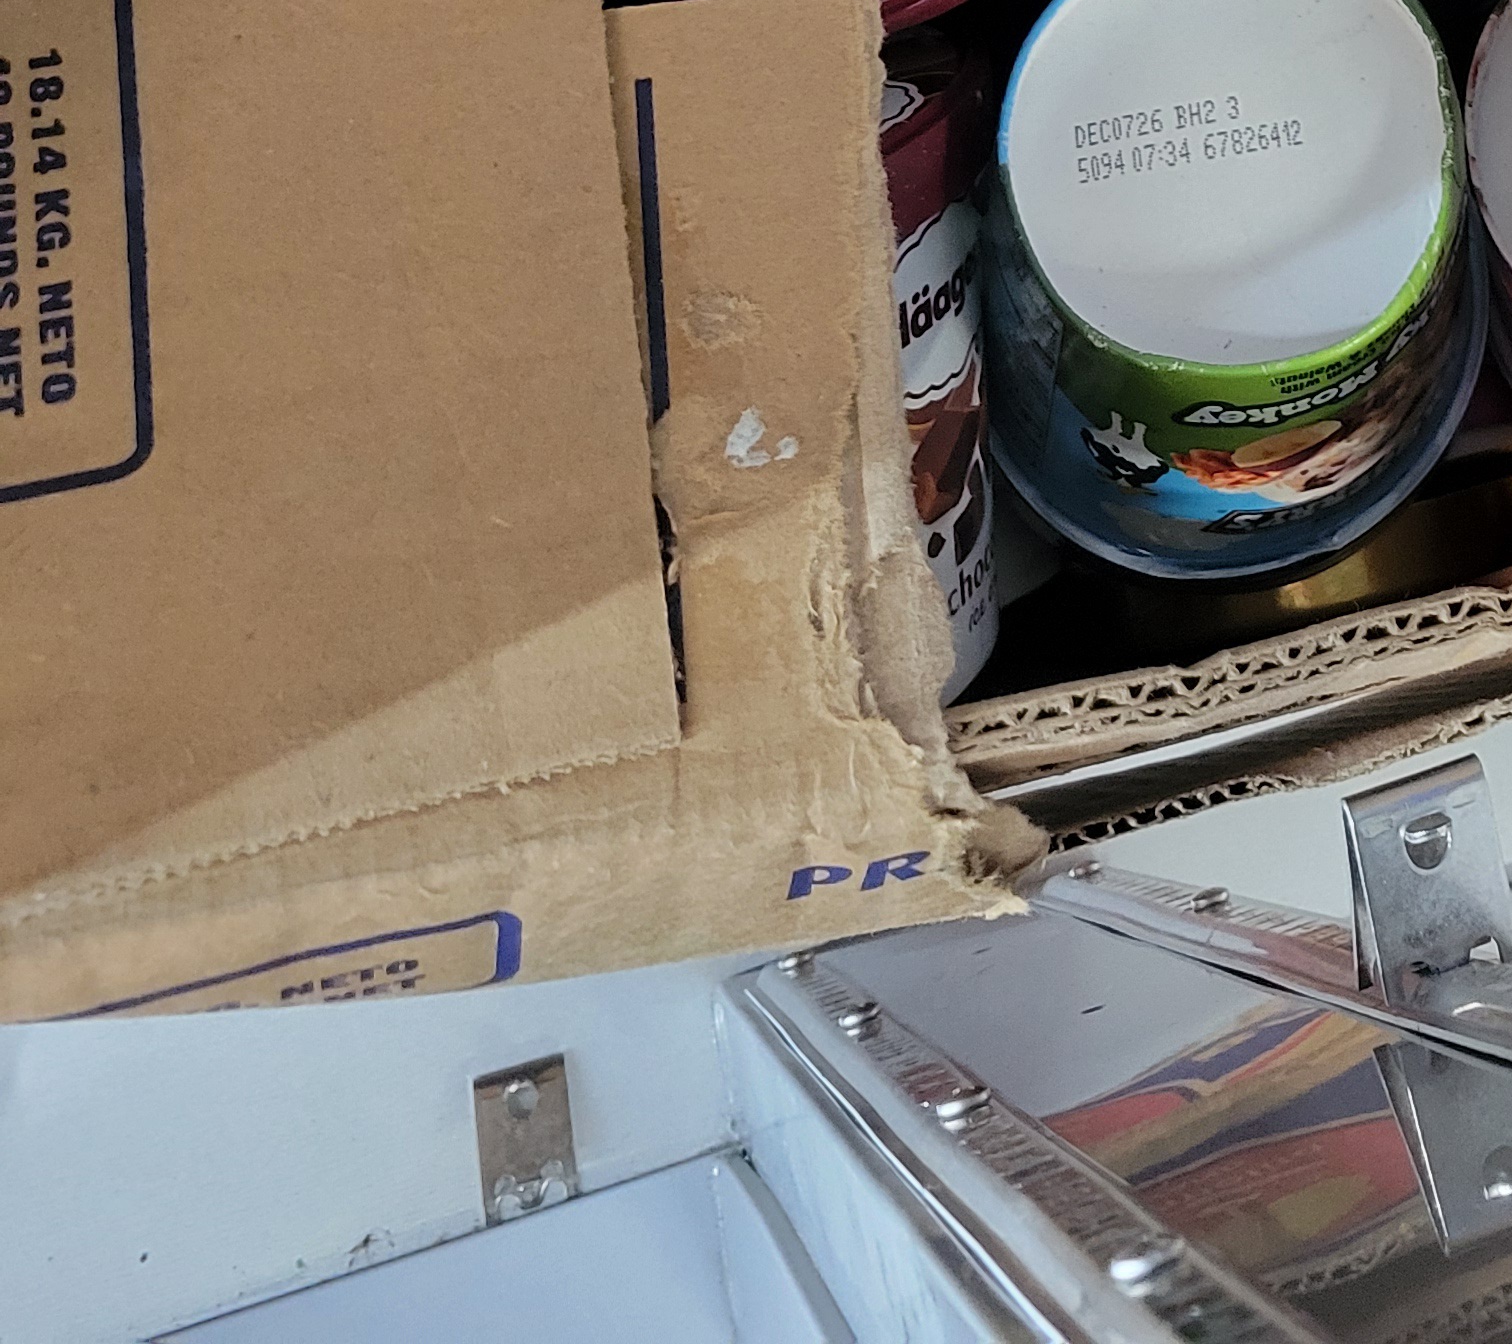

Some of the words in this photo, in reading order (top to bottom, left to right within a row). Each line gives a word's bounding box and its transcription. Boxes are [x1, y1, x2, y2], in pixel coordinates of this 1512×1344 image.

[27, 48, 67, 175] 18.14
[1073, 108, 1165, 150] DEC0726
[1173, 100, 1219, 130] BH2
[1226, 95, 1241, 120] 3
[1076, 149, 1128, 184] 5094
[1131, 140, 1192, 173] 07:34
[1203, 119, 1304, 162] 67826412
[34, 188, 72, 268] KG.
[38, 279, 76, 404] NETO
[1188, 356, 1381, 428] Monkey
[1279, 375, 1320, 395] with
